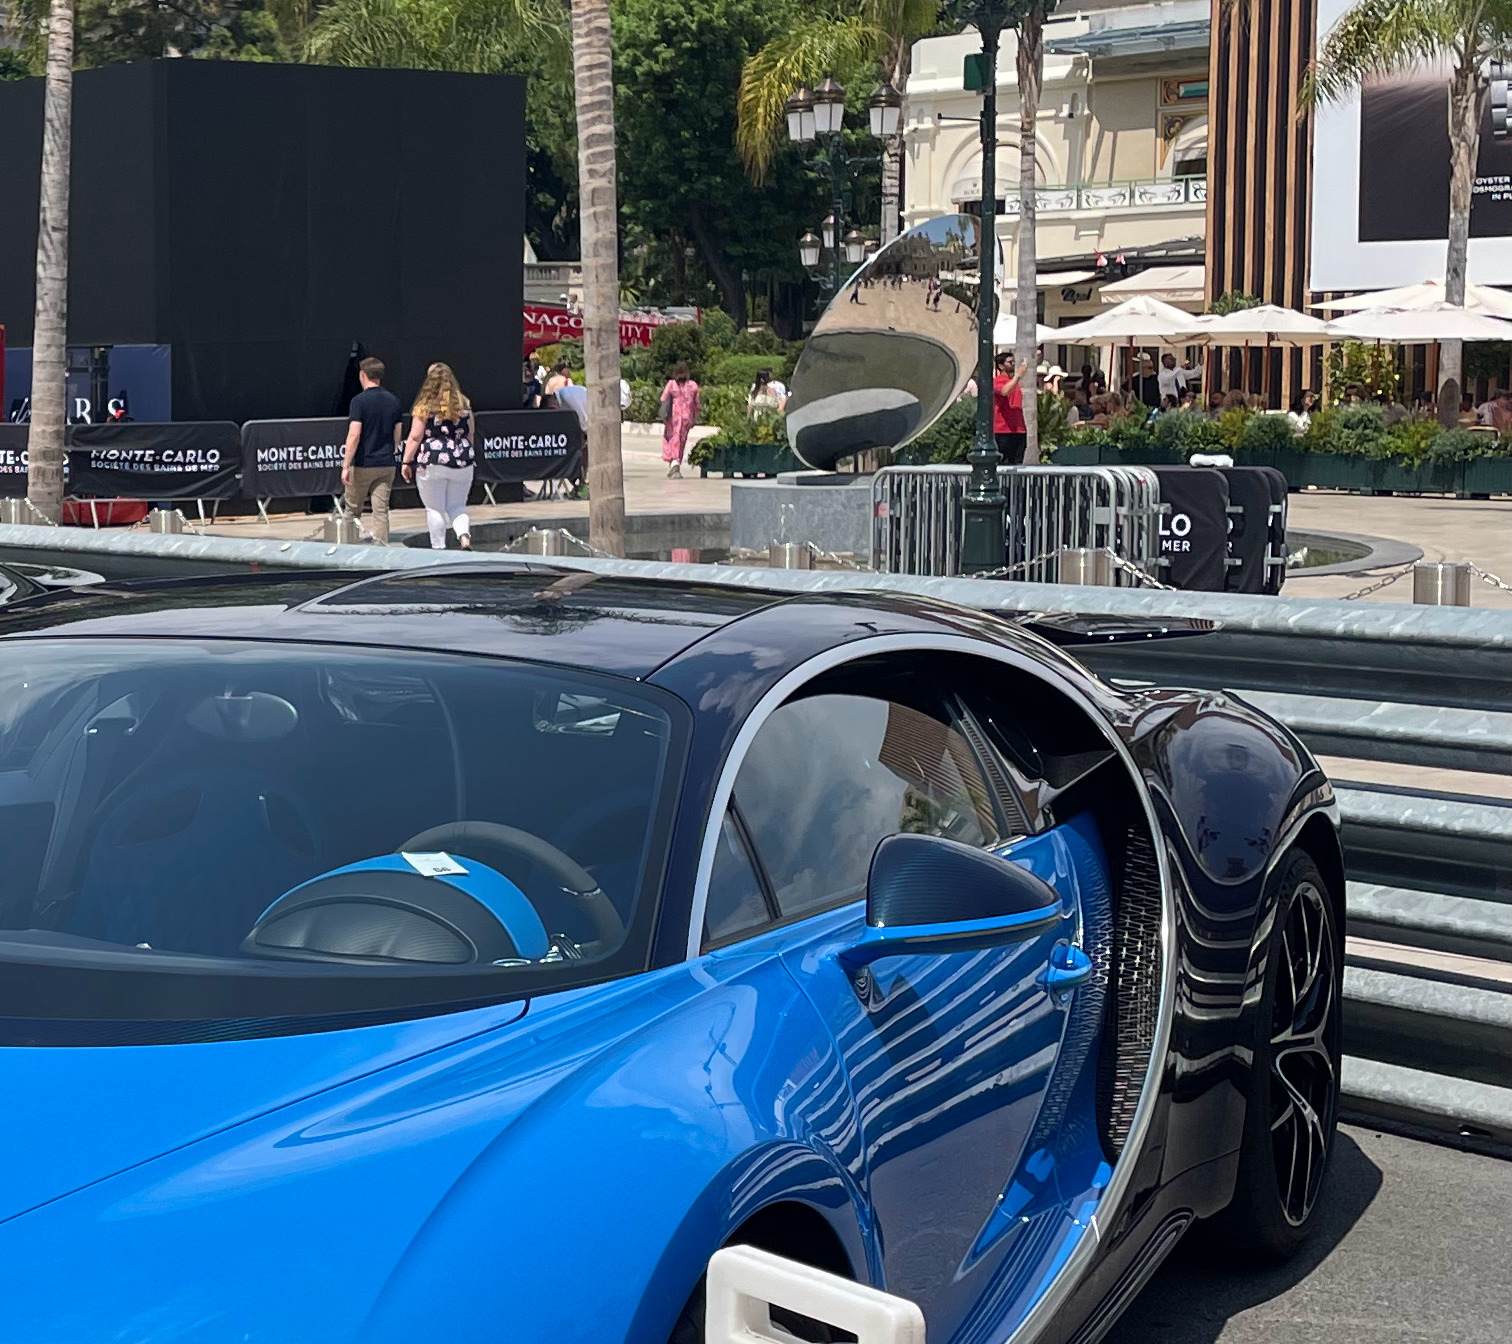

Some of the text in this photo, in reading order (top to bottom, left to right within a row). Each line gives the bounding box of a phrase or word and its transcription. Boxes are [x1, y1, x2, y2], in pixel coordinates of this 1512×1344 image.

[1476, 176, 1510, 185] OYSTER
[1473, 185, 1512, 193] OSMOGR
[523, 311, 584, 329] NACO
[619, 323, 643, 339] ITY
[553, 448, 567, 456] MER
[132, 463, 151, 472] DES
[154, 464, 183, 472] BAINS
[185, 464, 198, 472] DE
[200, 464, 220, 472] MER
[288, 460, 303, 471] DES
[303, 460, 324, 469] BAINS
[325, 459, 334, 468] DE
[1158, 513, 1192, 537] LO
[1161, 539, 1191, 552] MER
